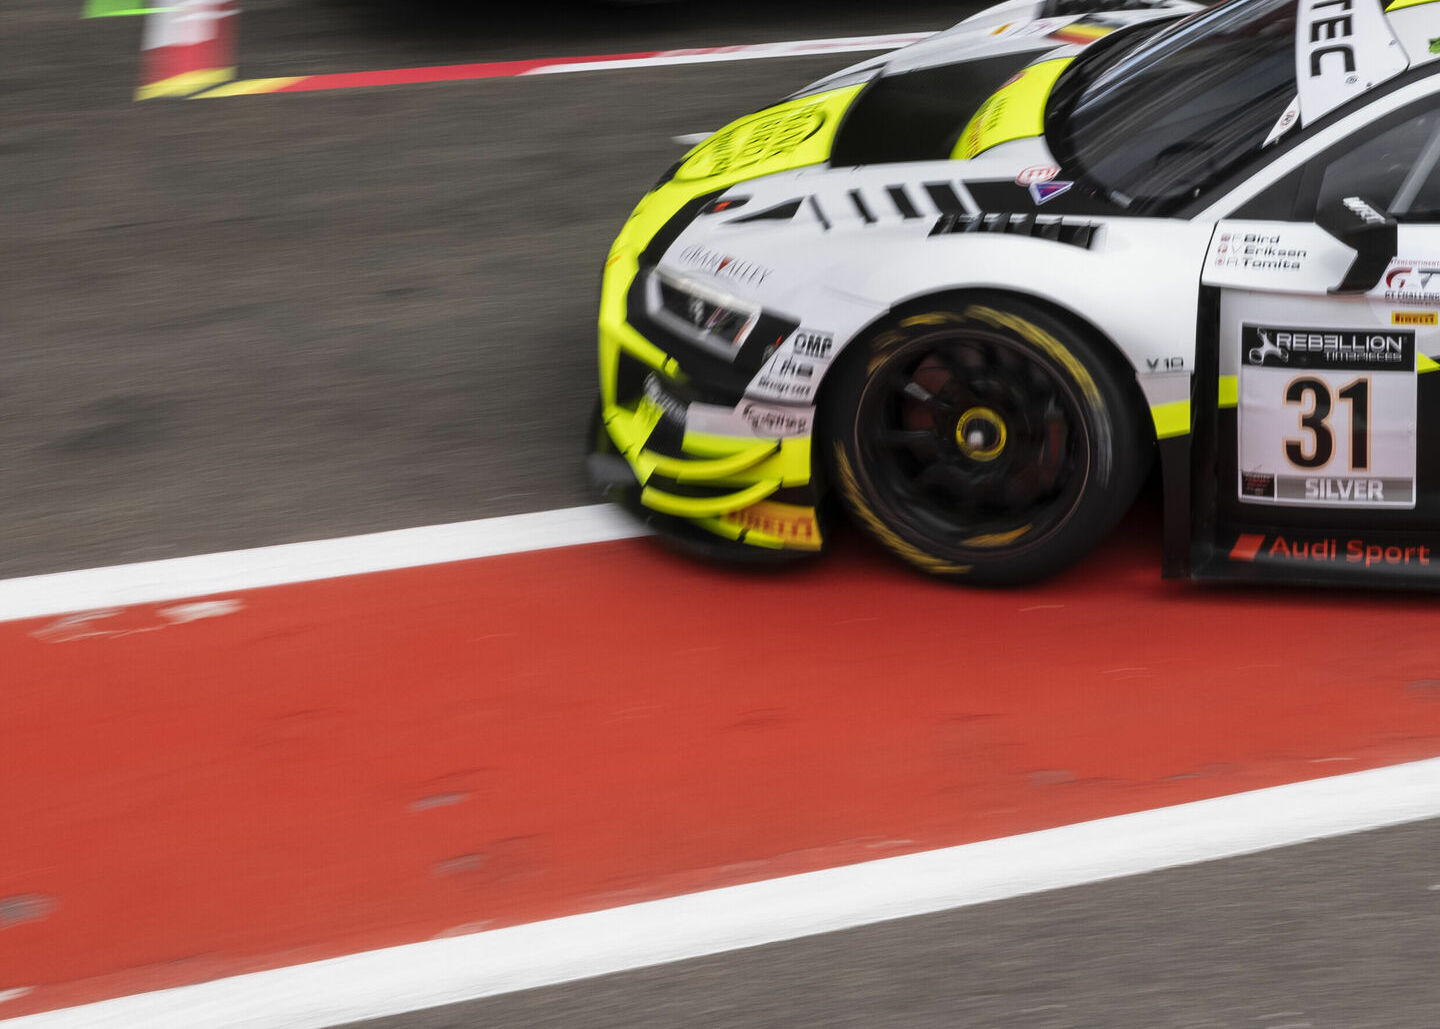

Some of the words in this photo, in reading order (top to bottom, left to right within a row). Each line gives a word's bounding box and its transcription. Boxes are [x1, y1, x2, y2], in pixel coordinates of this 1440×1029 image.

[1244, 234, 1280, 244] Bird
[1242, 257, 1301, 269] Tomita
[1276, 332, 1402, 353] REBELLION
[1282, 372, 1374, 473] 31
[1305, 478, 1384, 502] SILVER
[1268, 536, 1337, 562] Audi
[1346, 539, 1431, 569] Sport
